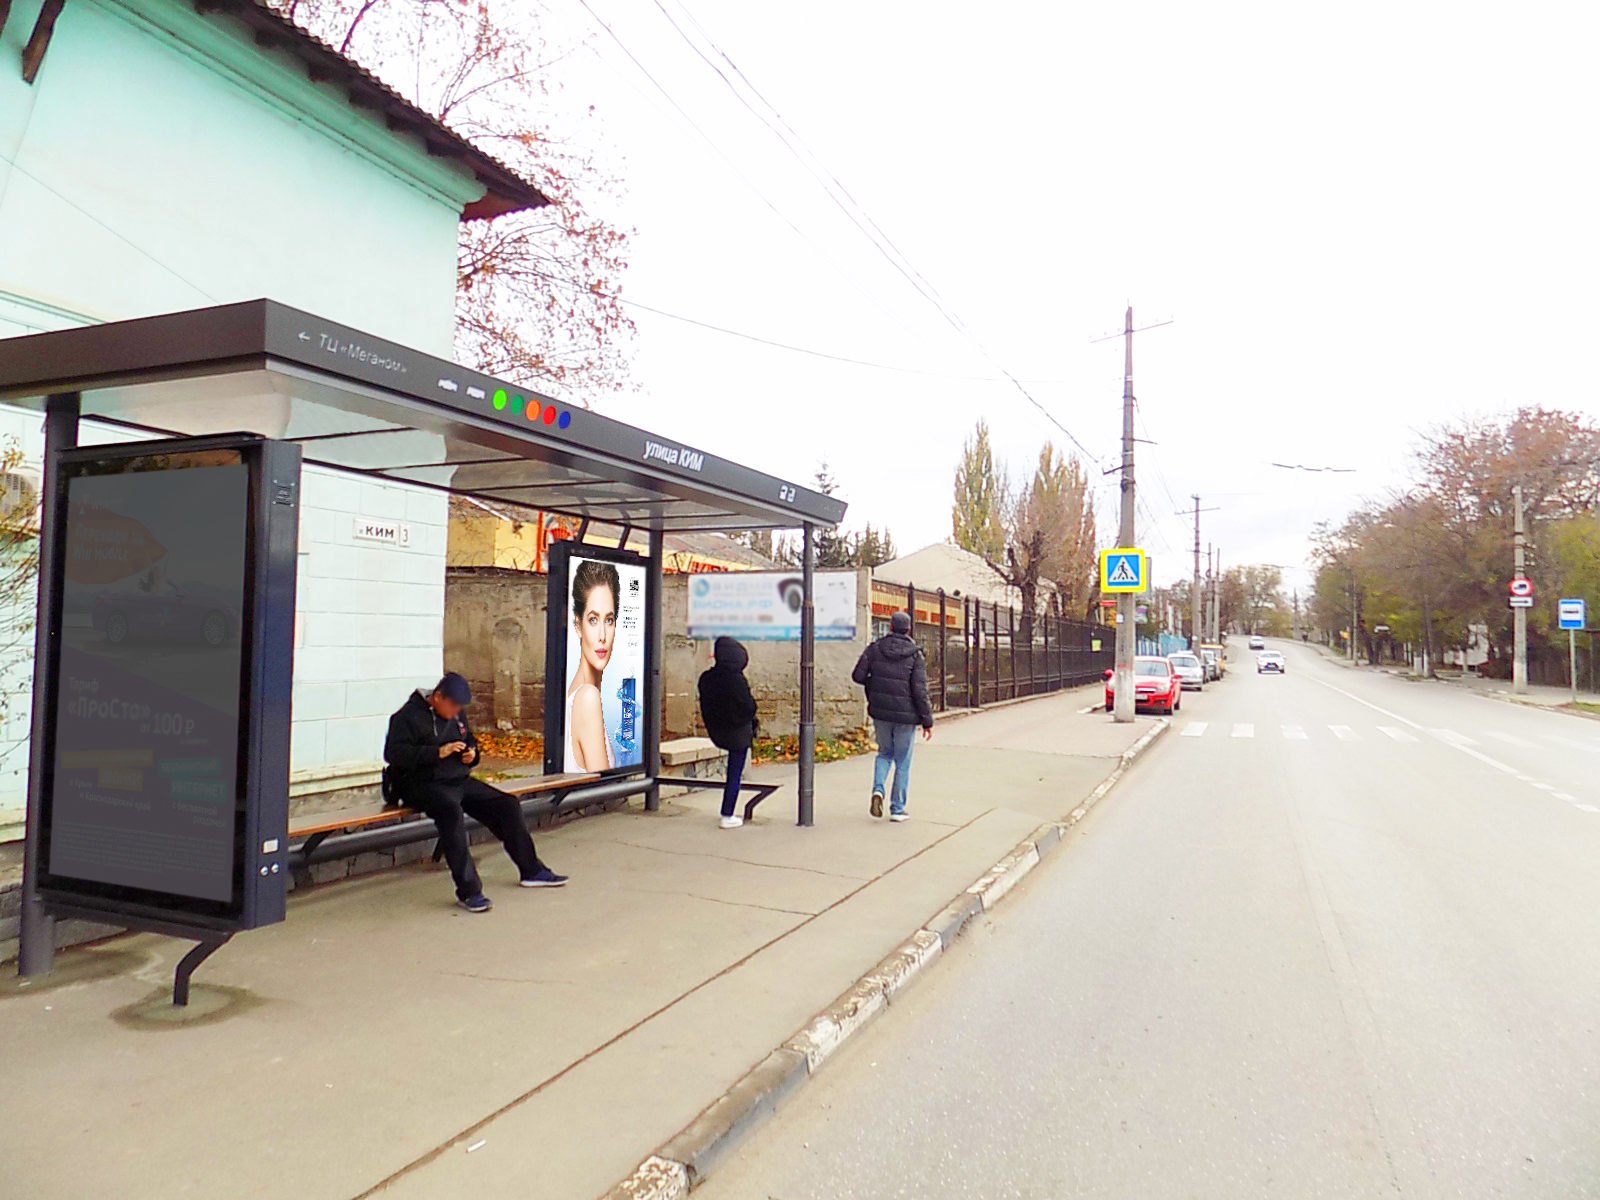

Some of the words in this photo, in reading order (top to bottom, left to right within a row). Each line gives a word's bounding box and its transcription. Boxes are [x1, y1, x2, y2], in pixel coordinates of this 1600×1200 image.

[320, 333, 338, 353] ТЦ
[643, 440, 678, 465] улица
[678, 448, 704, 472] КИМ
[365, 525, 394, 539] КИМ
[402, 528, 409, 543] 3
[68, 677, 99, 694] Тариф
[140, 722, 151, 734] от
[153, 712, 183, 735] 100
[74, 777, 93, 789] Крым
[100, 770, 141, 786] ЗВОНКИ
[172, 780, 225, 798] ИНТЕРНЕТ
[177, 801, 218, 816] бесплатной
